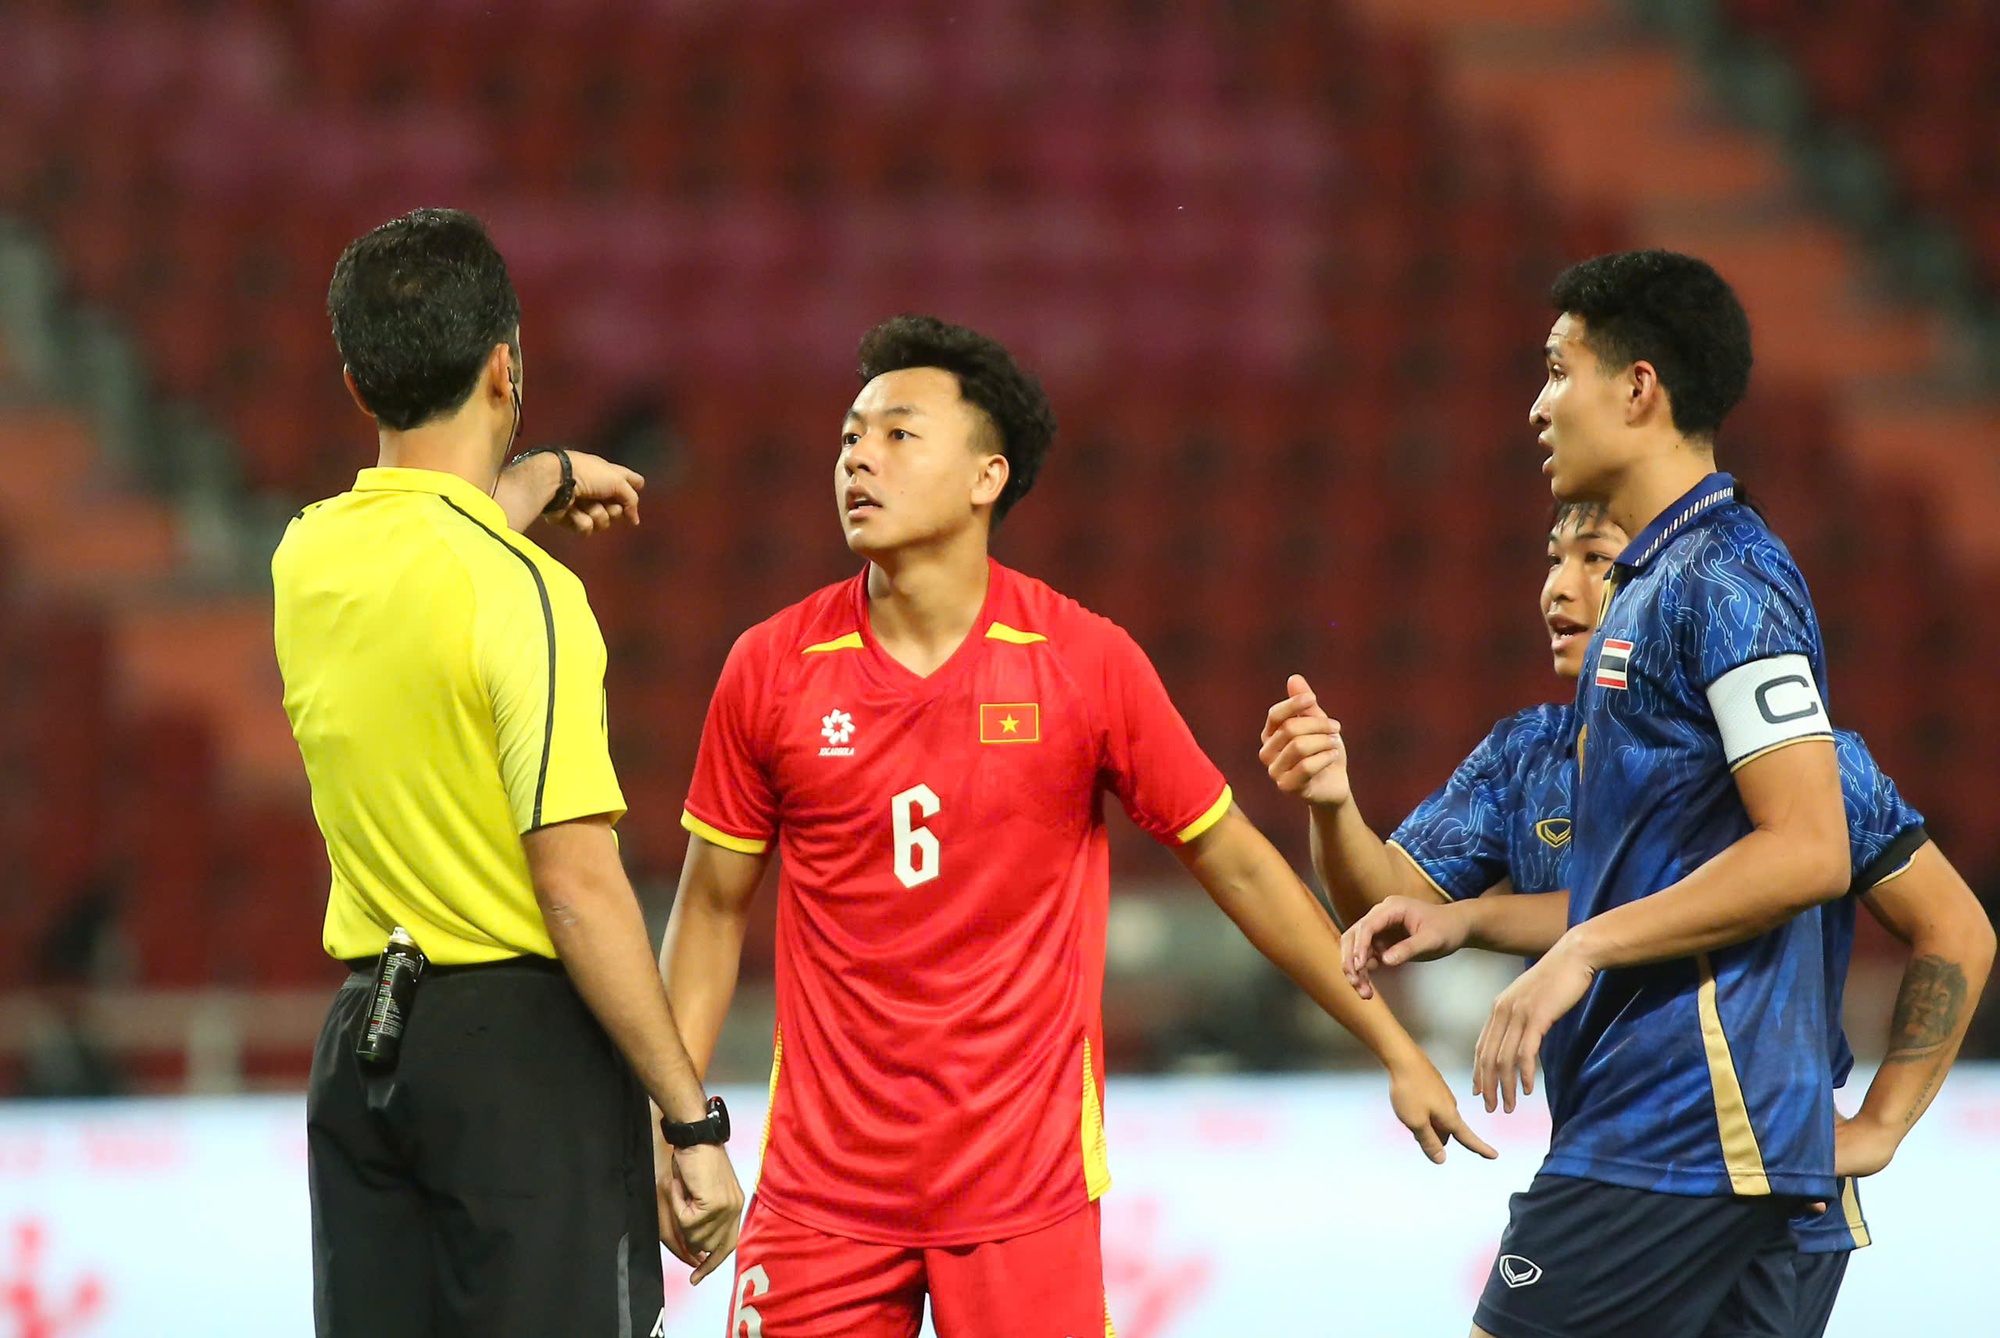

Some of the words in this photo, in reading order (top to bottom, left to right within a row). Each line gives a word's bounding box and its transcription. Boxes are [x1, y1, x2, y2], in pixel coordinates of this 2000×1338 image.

[1755, 675, 1818, 724] C
[891, 783, 941, 888] 6
[732, 1264, 770, 1338] 6
